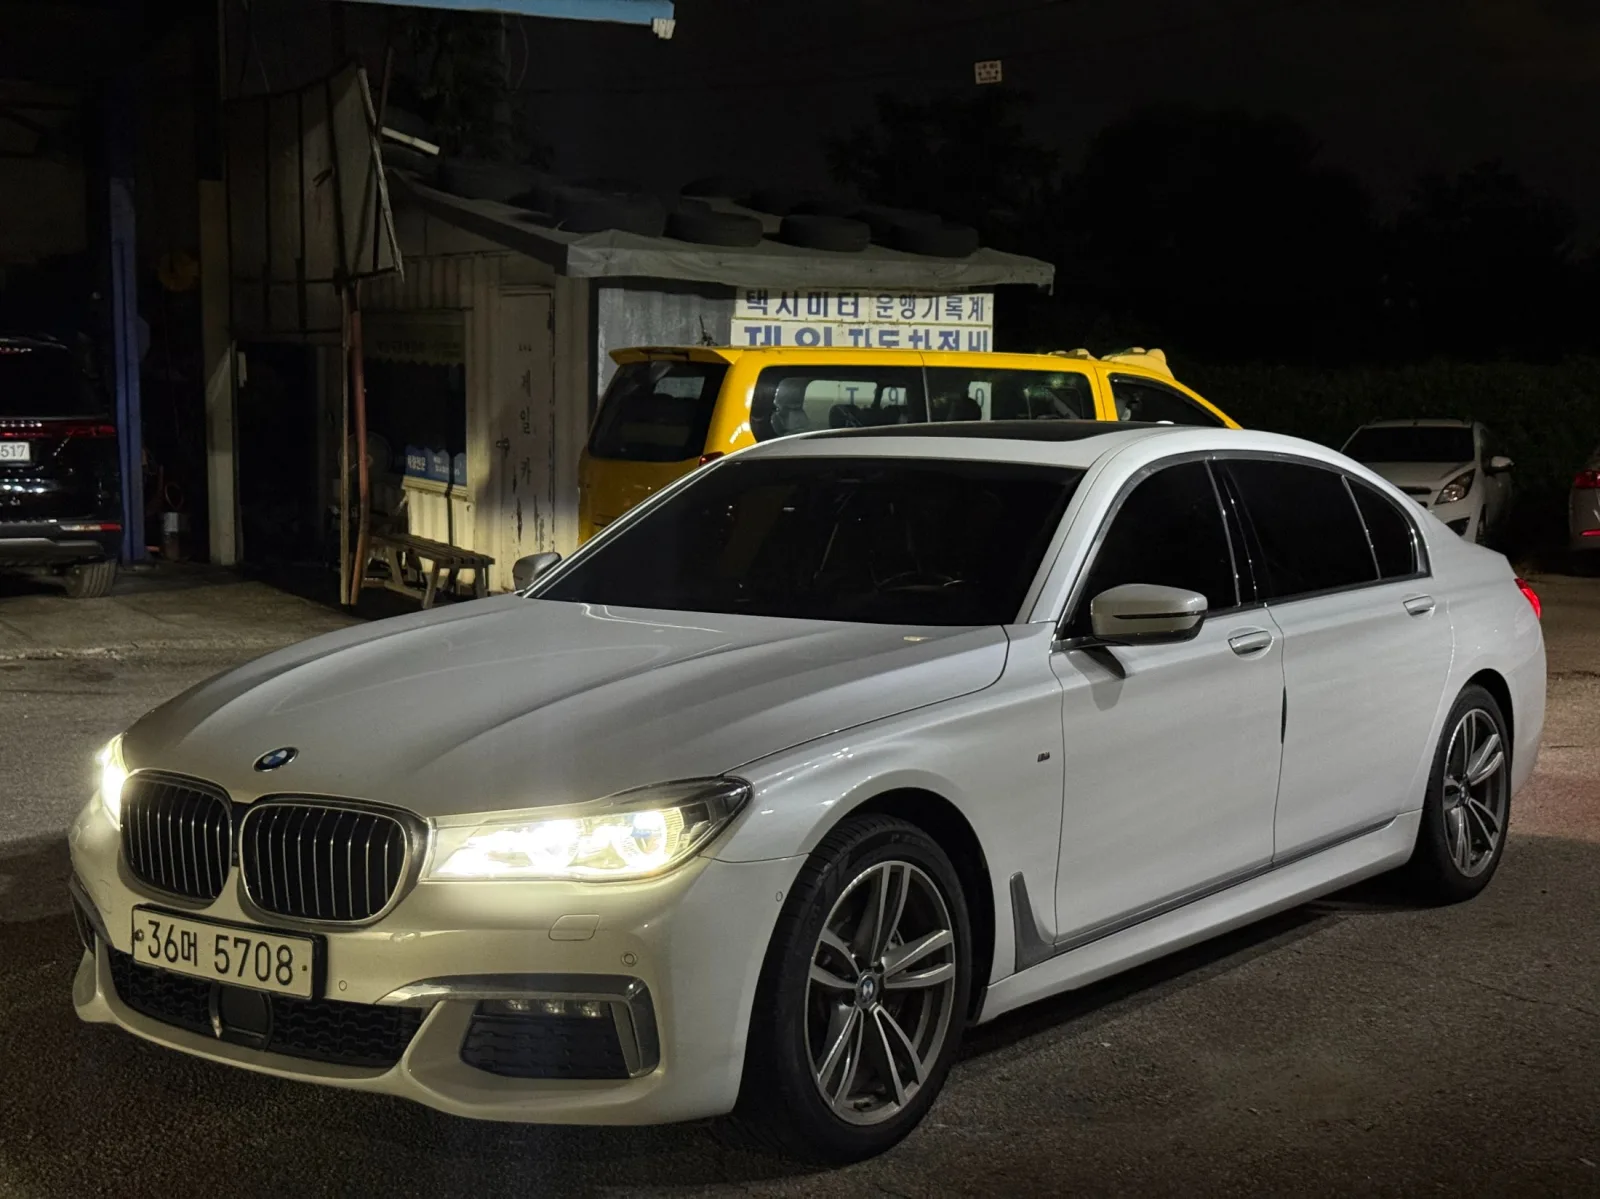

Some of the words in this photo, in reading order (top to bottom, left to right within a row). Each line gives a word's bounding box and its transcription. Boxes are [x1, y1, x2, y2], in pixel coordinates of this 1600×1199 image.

[746, 289, 860, 318] 택시미터
[148, 920, 198, 967] 36머
[214, 934, 293, 986] 5708
